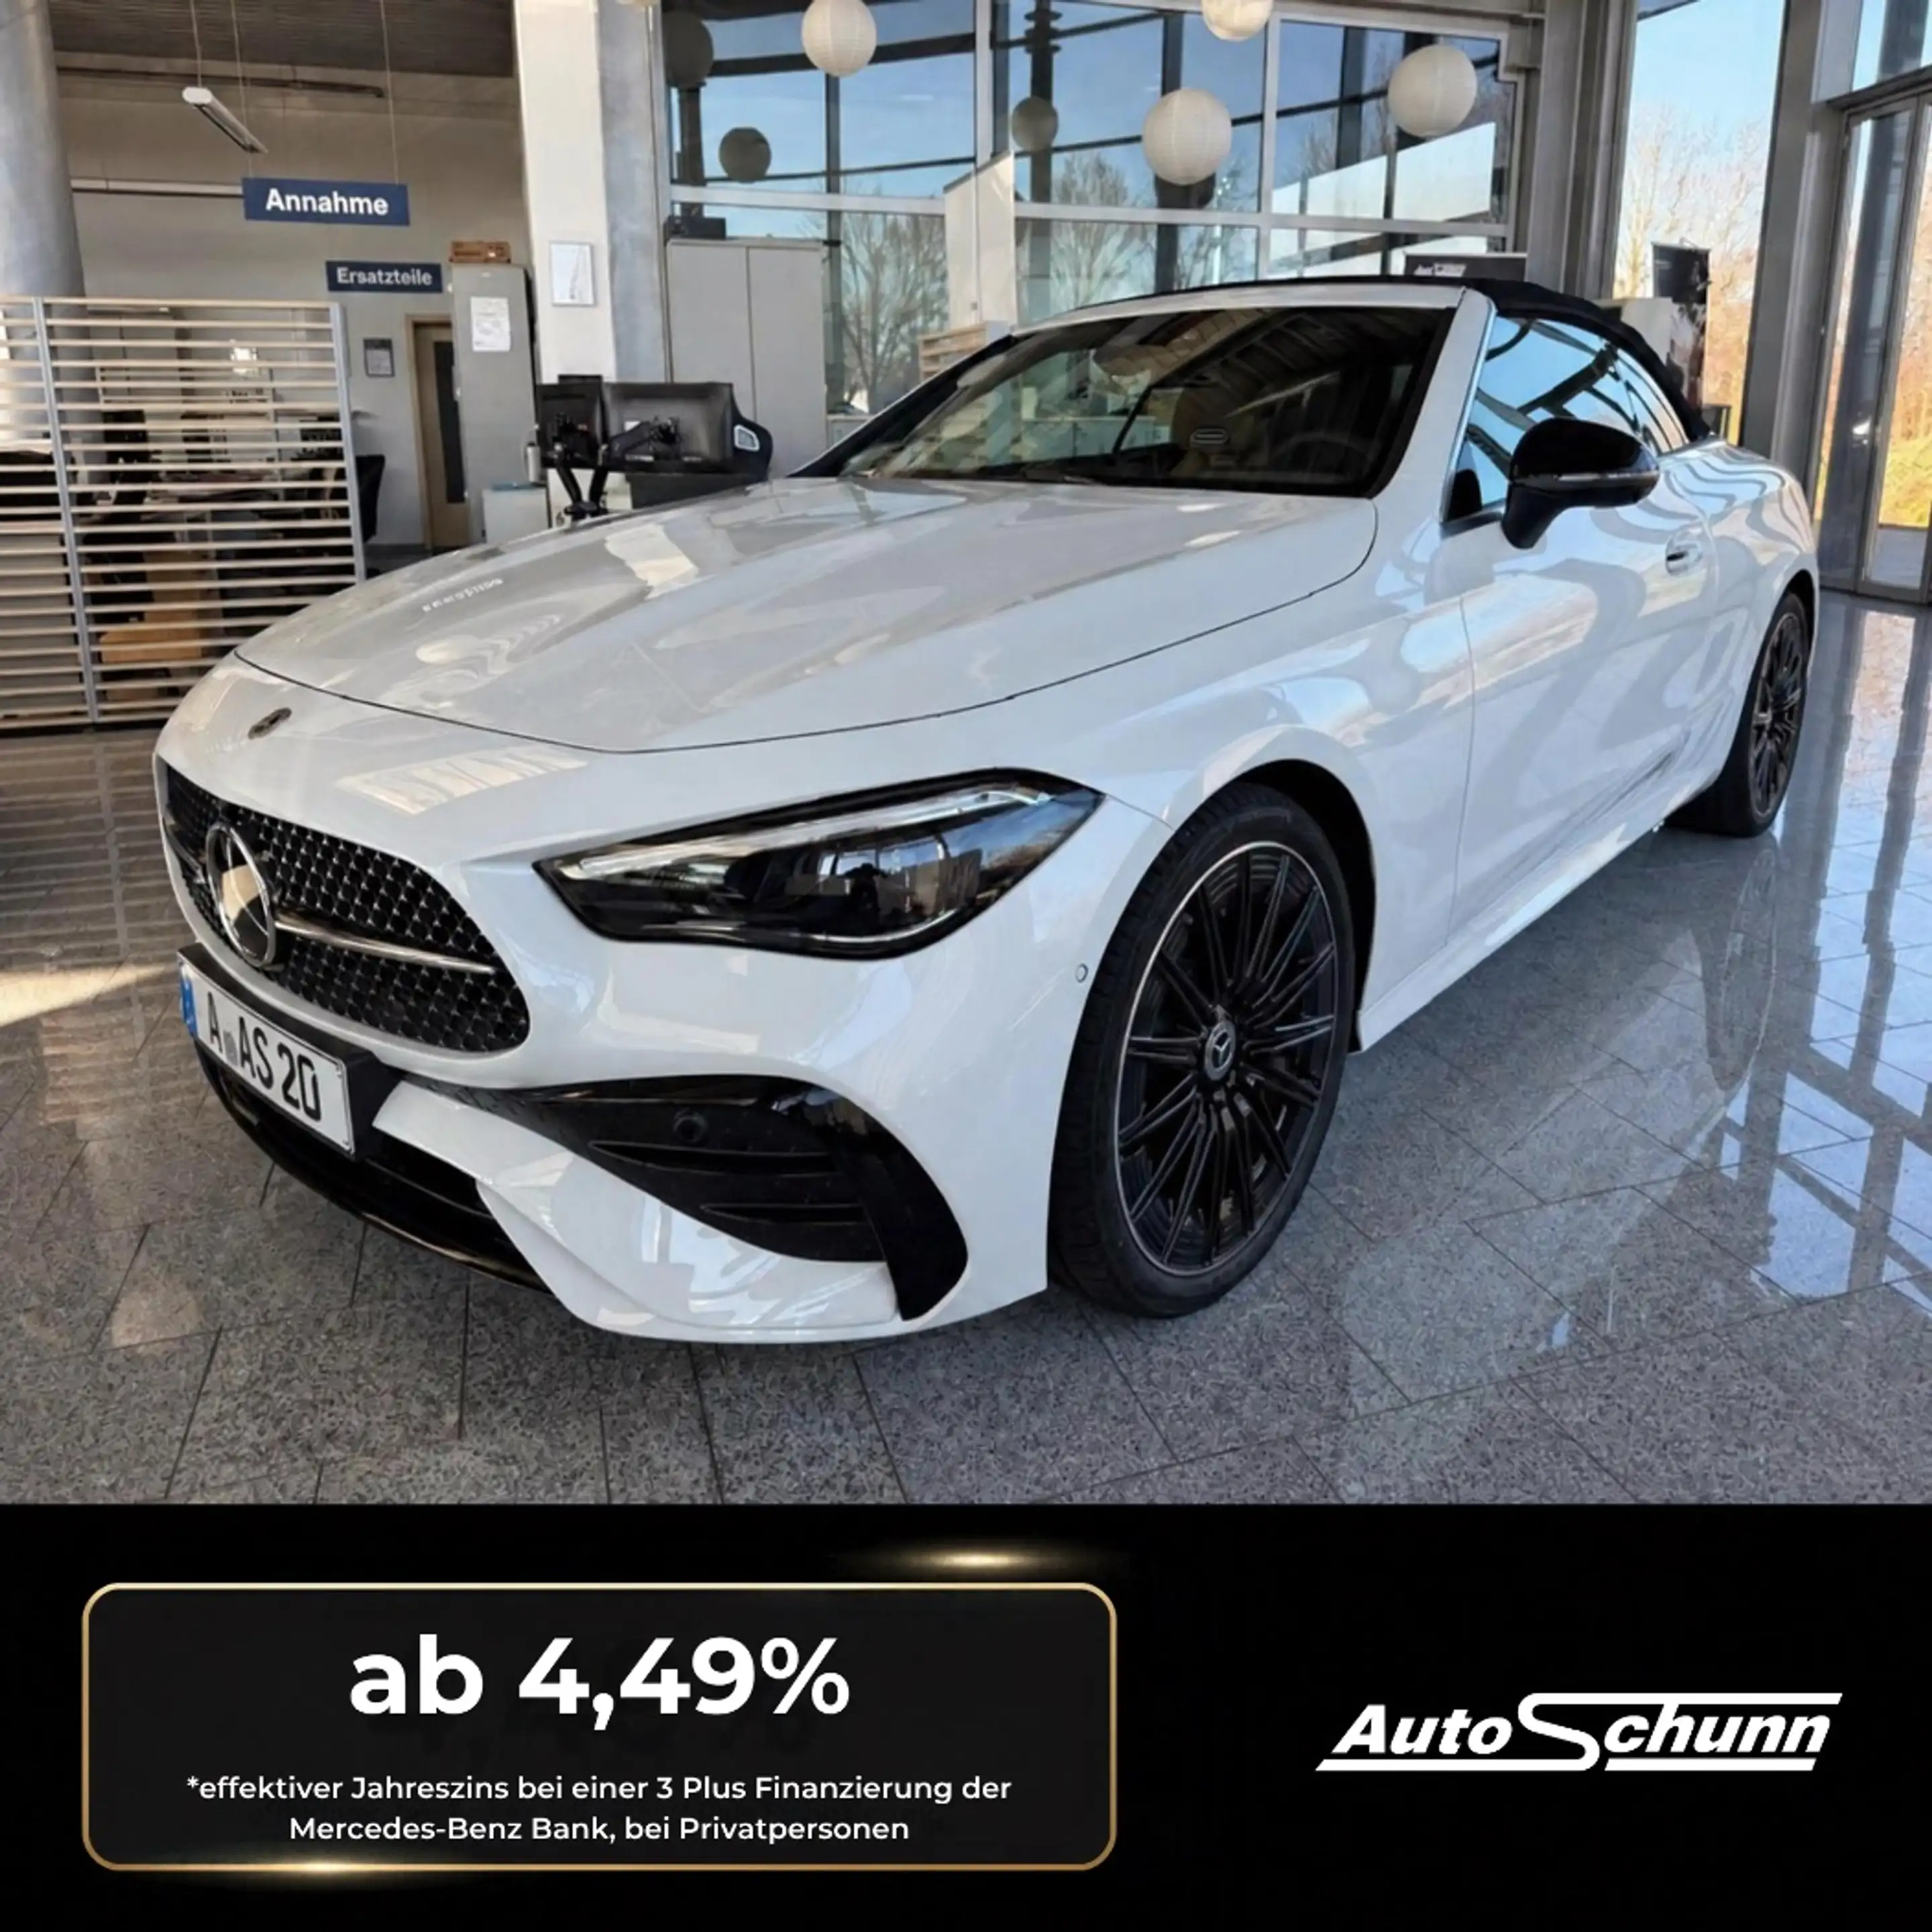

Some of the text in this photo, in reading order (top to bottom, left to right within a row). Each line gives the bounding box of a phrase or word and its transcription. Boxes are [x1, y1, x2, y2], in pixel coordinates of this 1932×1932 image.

[265, 187, 389, 216] Annahme
[336, 266, 433, 286] Ersatzteile
[207, 991, 322, 1122] A AS 20
